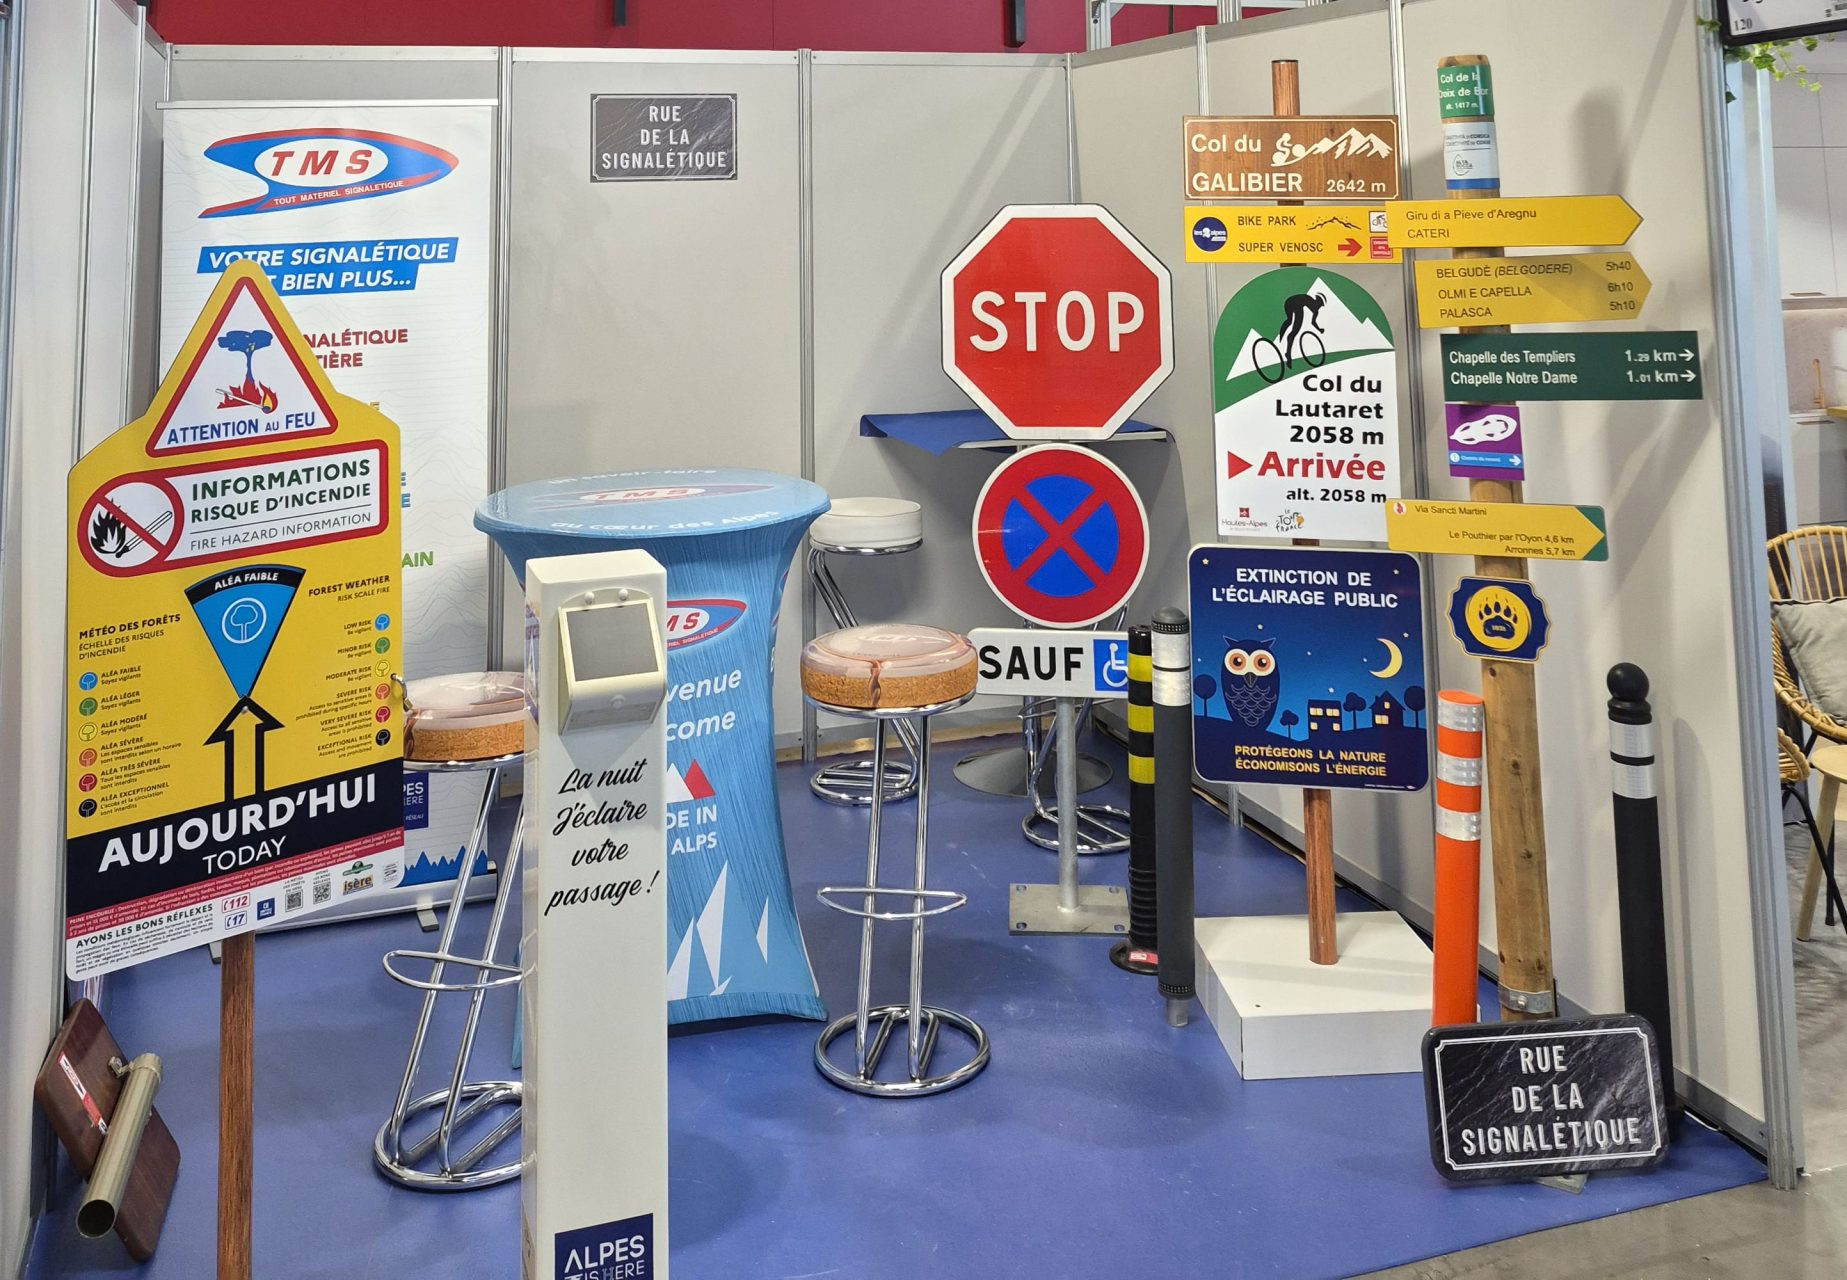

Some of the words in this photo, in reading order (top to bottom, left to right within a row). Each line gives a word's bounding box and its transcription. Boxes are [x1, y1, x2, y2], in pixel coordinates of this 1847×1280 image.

[1734, 19, 1752, 31] 120
[1441, 74, 1453, 83] Col
[1456, 73, 1468, 81] de
[650, 106, 681, 121] RUE
[640, 129, 661, 145] DE
[670, 129, 690, 145] LA
[1191, 134, 1226, 153] Col
[1235, 134, 1262, 153] du
[271, 150, 372, 176] TMS
[602, 148, 726, 170] SIGNALÉTIQUE
[1193, 173, 1302, 192] GALIBIER
[1327, 180, 1365, 192] 2642
[1371, 183, 1385, 192] m
[274, 196, 296, 205] TOUT
[301, 190, 340, 201] MATERIEL
[345, 180, 404, 195] SIGNALETIQUE
[1238, 216, 1262, 225] BIKE
[1269, 216, 1296, 225] PARK
[1406, 211, 1428, 220] Giru
[1431, 210, 1441, 220] di
[1453, 210, 1484, 220] Pieve
[1487, 209, 1537, 222] d'Aregnu
[1408, 229, 1450, 238] CATERI
[290, 242, 450, 265] SIGNALÉTIQUE
[1239, 243, 1274, 252] SUPER
[1280, 243, 1323, 252] VENOSC
[1495, 263, 1572, 278] (BELGODERE)
[1606, 261, 1631, 271] 5h40
[282, 272, 337, 290] BIEN
[340, 270, 410, 287] PLUS...
[1439, 289, 1467, 299] OLMI
[1480, 286, 1532, 297] CAPELLA
[1440, 308, 1492, 318] PALASCA
[1610, 301, 1635, 311] 5h10
[970, 291, 1144, 353] STOP
[1450, 351, 1497, 366] Chapelle
[1500, 352, 1520, 363] des
[1523, 350, 1576, 365] Templiers
[1653, 349, 1677, 361] km
[1303, 375, 1341, 392] Col
[1351, 376, 1381, 393] du
[1451, 372, 1502, 387] Chapelle
[1507, 373, 1539, 384] Notre
[1542, 372, 1578, 383] Dame
[1655, 371, 1679, 382] km
[1276, 400, 1383, 418] Lautaret
[167, 419, 258, 445] ATTENTION
[265, 421, 280, 432] AU
[285, 412, 315, 429] FEU
[1290, 426, 1353, 443] 2058
[1362, 432, 1383, 444] m
[1258, 452, 1385, 480] Arrivée
[192, 458, 370, 501] INFORMATIONS
[191, 496, 259, 523] RISQUE
[266, 483, 371, 511] D'INCENDIE
[1286, 489, 1314, 500] alt.
[1320, 489, 1365, 502] 2058
[1372, 493, 1386, 503] m
[1458, 507, 1487, 515] Martini
[190, 538, 216, 551] FIRE
[221, 528, 278, 546] HAZARD
[282, 512, 371, 535] INFORMATION
[1449, 531, 1460, 539] Le
[1462, 531, 1497, 540] Pouthier
[1499, 534, 1513, 542] par
[1560, 535, 1574, 543] km
[1505, 546, 1544, 555] Arronnes
[1546, 547, 1559, 556] 5,7
[1562, 548, 1575, 556] km
[214, 574, 242, 590] ALÉA
[245, 572, 278, 583] FAIBLE
[309, 582, 343, 596] FOREST
[345, 575, 390, 590] WEATHER
[1236, 568, 1338, 585] EXTINCTION
[1348, 572, 1371, 586] DE
[338, 592, 352, 602] RISK
[354, 590, 374, 599] SCALE
[376, 586, 390, 594] FIRE
[1213, 585, 1325, 605] L'ÉCLAIRAGE
[1334, 592, 1398, 607] PUBLIC
[79, 625, 116, 639] MÉTÉO
[119, 621, 138, 631] DES
[141, 614, 181, 627] FORÊTS
[79, 638, 113, 651] ÉCHELLE
[115, 636, 130, 644] DES
[132, 629, 164, 641] RISQUES
[79, 646, 126, 660] D'INCENDIE
[979, 645, 1084, 681] SAUF
[1235, 745, 1312, 759] PROTÉGEONS
[1319, 750, 1334, 760] LA
[1340, 751, 1386, 762] NATURE
[558, 768, 593, 794] La
[596, 758, 648, 788] nuit
[1236, 759, 1320, 773] ÉCONOMISONS
[1326, 763, 1386, 776] L'ÉNERGIE
[98, 773, 376, 873] AUJOURD'HUI
[696, 804, 717, 824] IN
[571, 839, 629, 866] votre
[671, 832, 717, 855] ALPS
[203, 835, 286, 874] TODAY
[344, 877, 372, 891] isère
[229, 896, 248, 908] 112
[544, 878, 642, 916] passage
[76, 933, 112, 948] AYONS
[116, 927, 132, 937] LES
[136, 919, 163, 931] BONS
[167, 904, 212, 922] RÉFLEXES
[232, 914, 245, 925] 17
[1520, 1045, 1567, 1074] RUE
[1512, 1085, 1543, 1113] DE
[1552, 1083, 1584, 1110] LA
[1461, 1116, 1641, 1156] SIGNALÉTIQUE
[565, 1235, 645, 1273] ALPES
